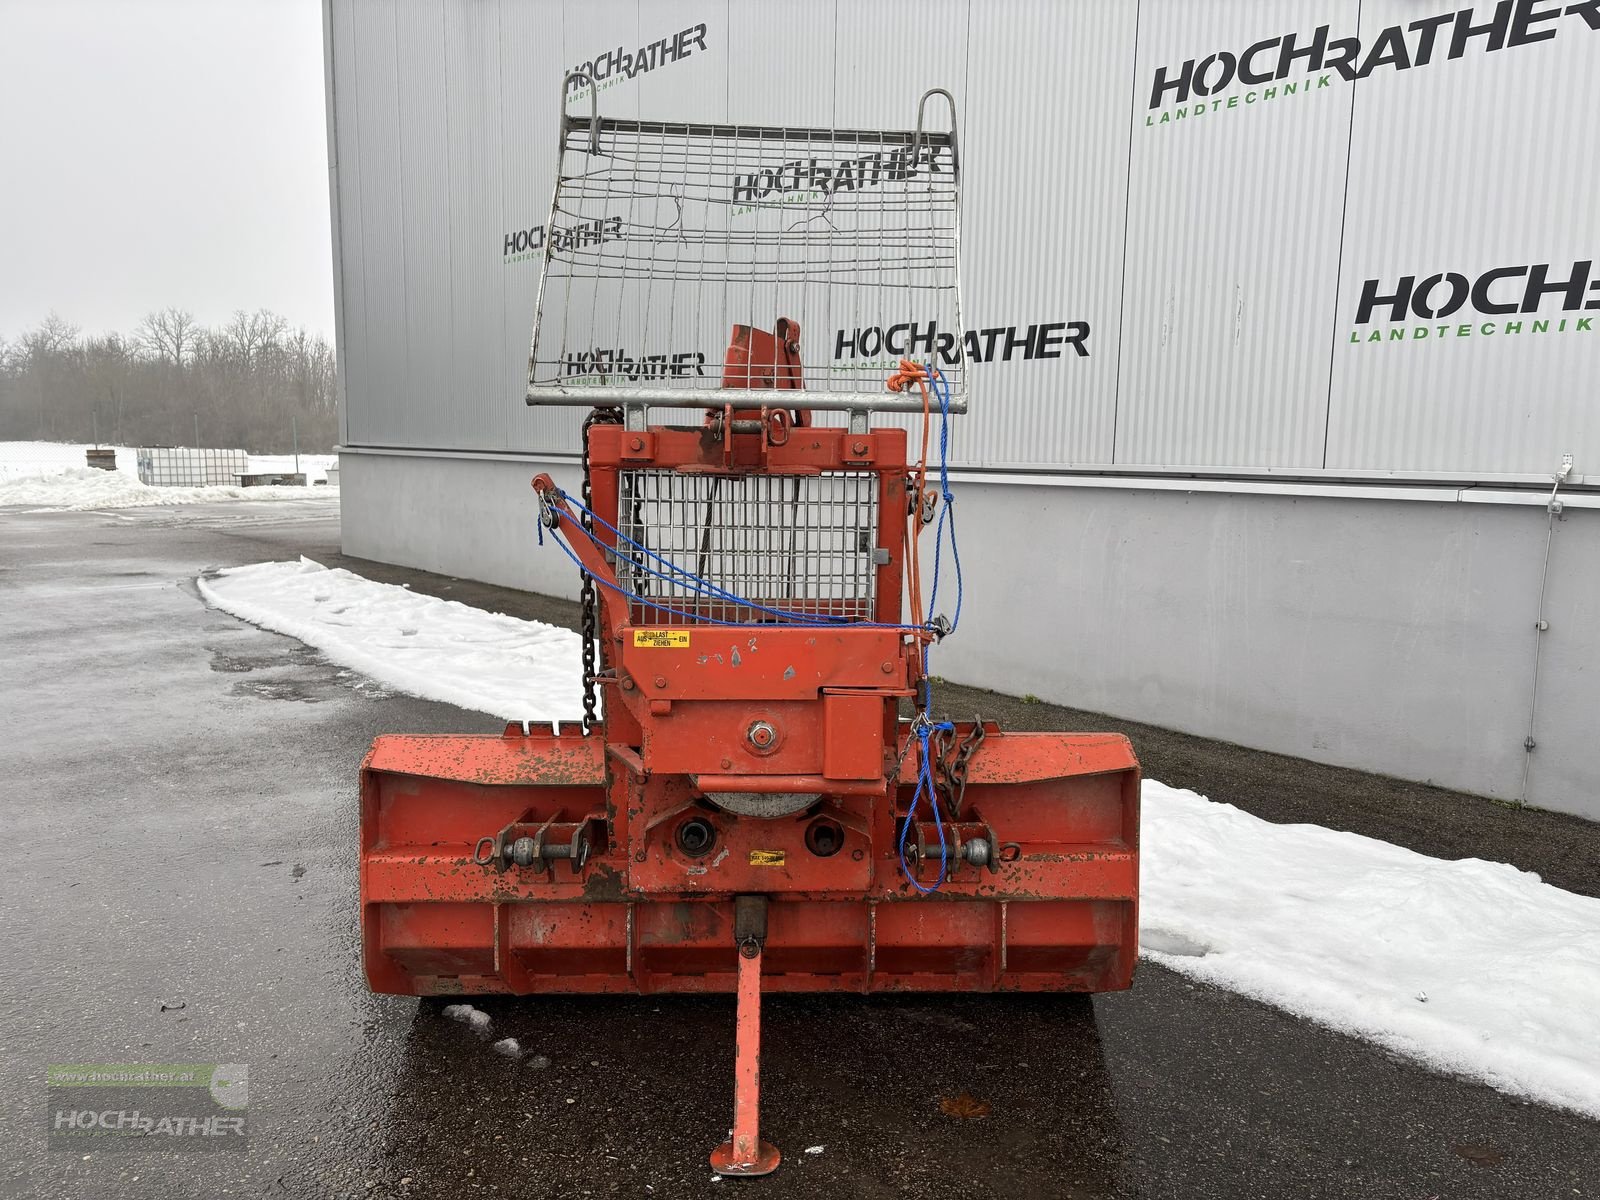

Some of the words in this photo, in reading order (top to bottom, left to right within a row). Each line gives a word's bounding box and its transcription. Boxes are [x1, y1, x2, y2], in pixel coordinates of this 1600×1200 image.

[565, 23, 708, 94] HOCHRATHER
[567, 76, 625, 103] ANDTCHNIK
[1146, 75, 1332, 126] LANDTECHNIK
[1355, 260, 1600, 325] HOCH
[834, 320, 1091, 364] HOCHRATHER
[1349, 317, 1593, 343] LANDTECHNIK
[566, 349, 705, 381] HOCHRATHER
